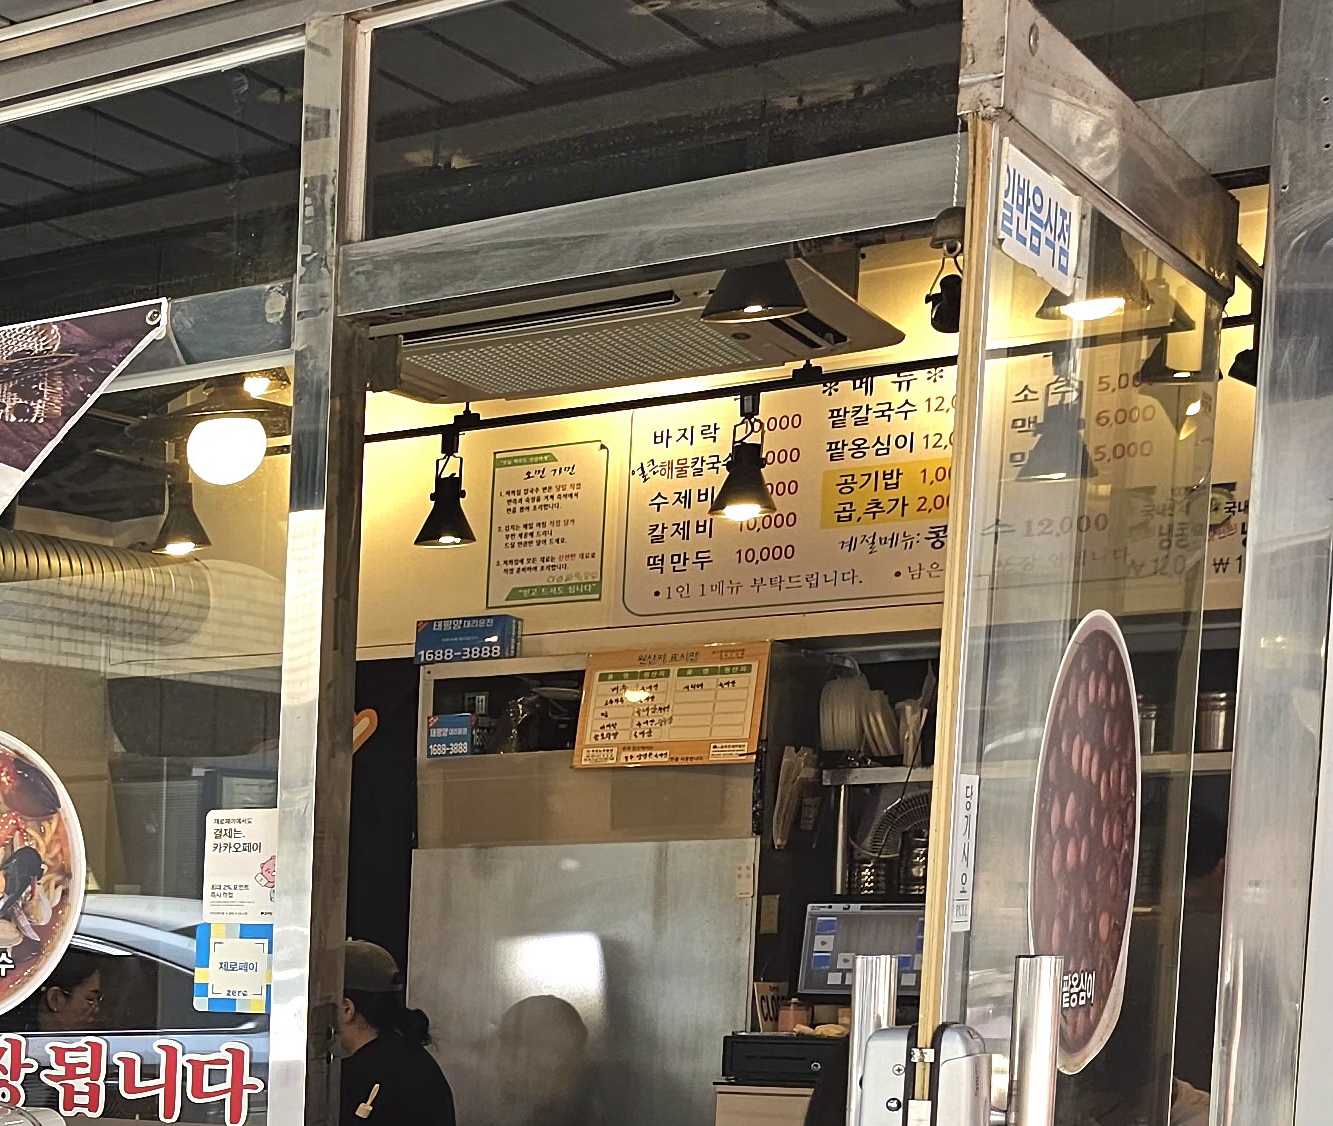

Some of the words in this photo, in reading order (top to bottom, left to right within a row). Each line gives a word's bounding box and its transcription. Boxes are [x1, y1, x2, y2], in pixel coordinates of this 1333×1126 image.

[1002, 162, 1072, 277] 일반음식점
[827, 398, 918, 430] 팥칼국수
[1094, 404, 1156, 428] 6,000
[653, 422, 721, 449] 바지락
[825, 431, 915, 462] 팥옹심이
[1093, 439, 1154, 463] 5,000
[835, 467, 904, 496] 공기밥
[648, 485, 716, 513] 수제비
[647, 517, 714, 545] 칼제비
[737, 511, 798, 533] 10,000
[1022, 512, 1109, 539] 12,000
[646, 549, 714, 575] 떡만두
[735, 544, 796, 565] 10,000
[665, 582, 691, 600] 1인
[700, 579, 744, 598] 1메뉴
[750, 568, 864, 595] 부탁드립니다.
[432, 618, 463, 631] 태평양
[417, 645, 501, 662] 1688-3888
[428, 742, 469, 756] 1688-3888
[213, 827, 246, 840] 결제는.
[960, 784, 974, 894] 당기시오
[212, 841, 262, 854] 카카오페이
[954, 903, 969, 919] PULL
[218, 959, 259, 973] 제로페이
